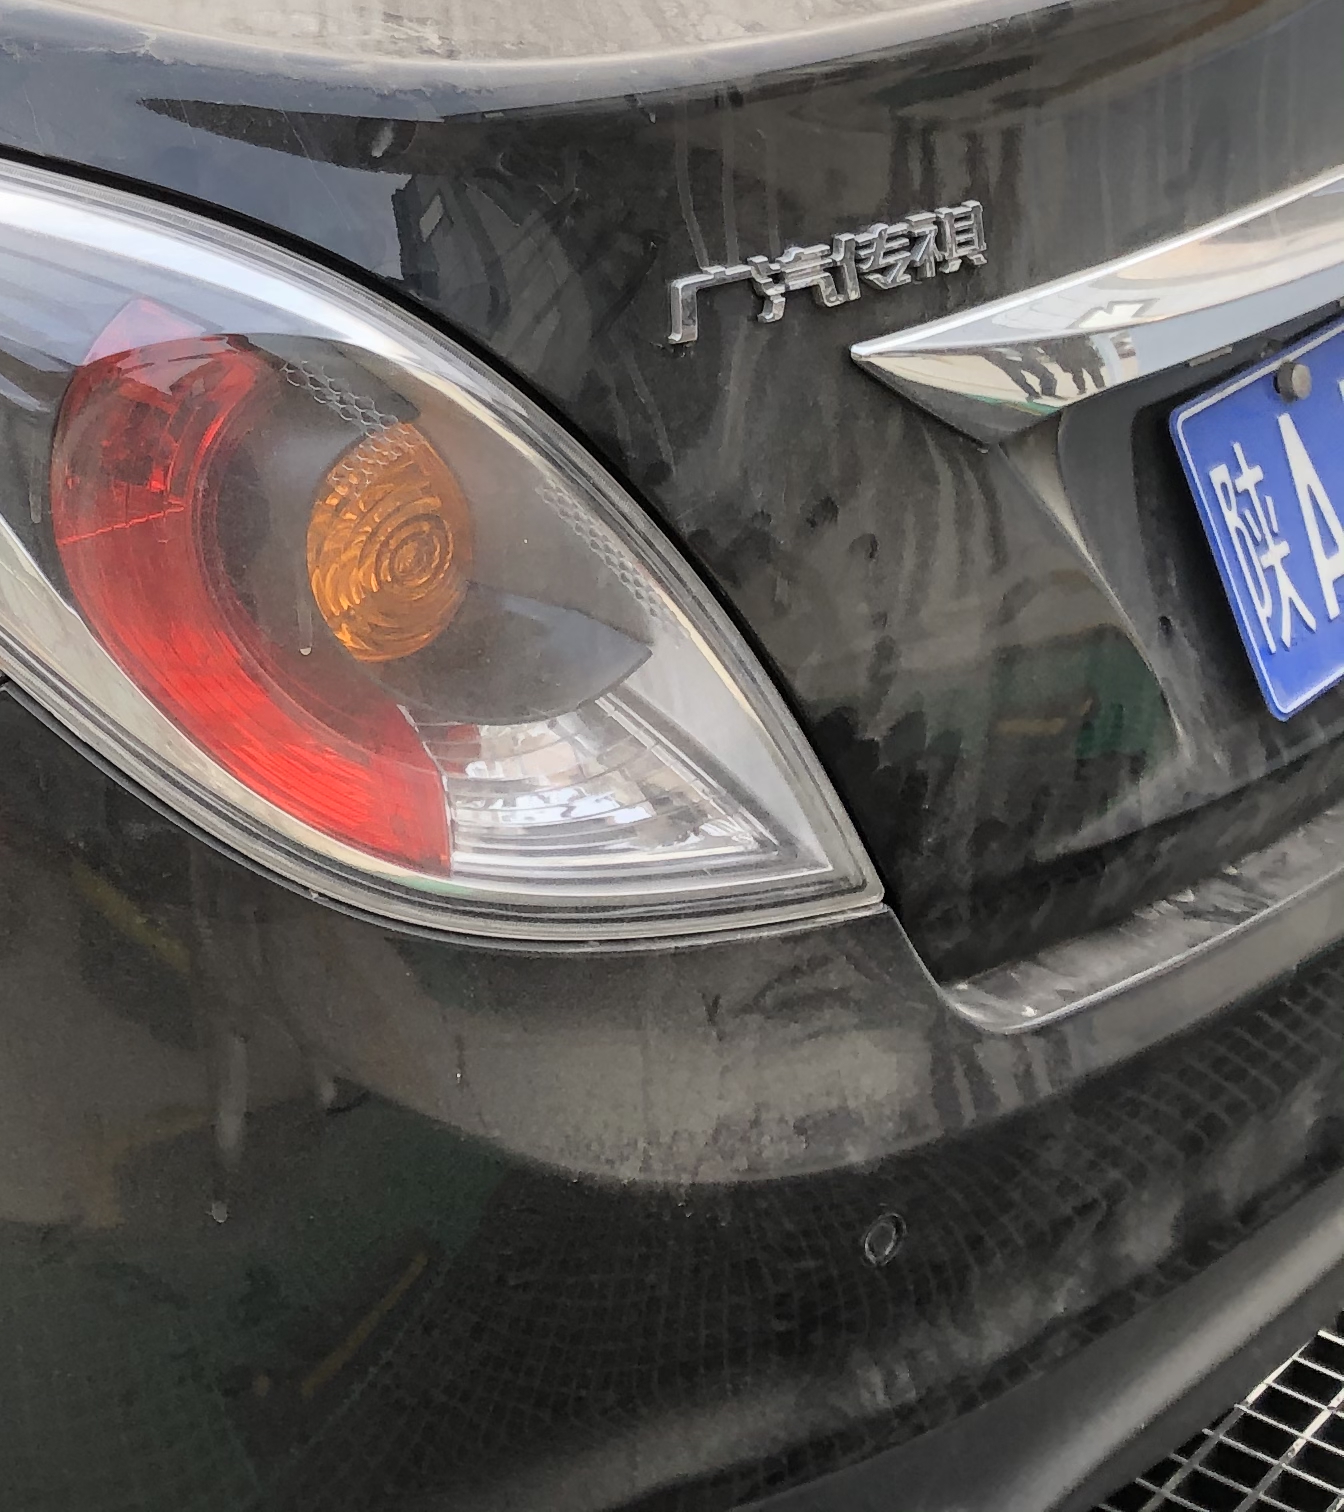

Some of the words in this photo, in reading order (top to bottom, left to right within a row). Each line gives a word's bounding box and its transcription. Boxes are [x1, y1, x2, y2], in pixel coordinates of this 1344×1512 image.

[668, 199, 988, 346] 广汽传祺
[1208, 412, 1344, 655] 陕A
